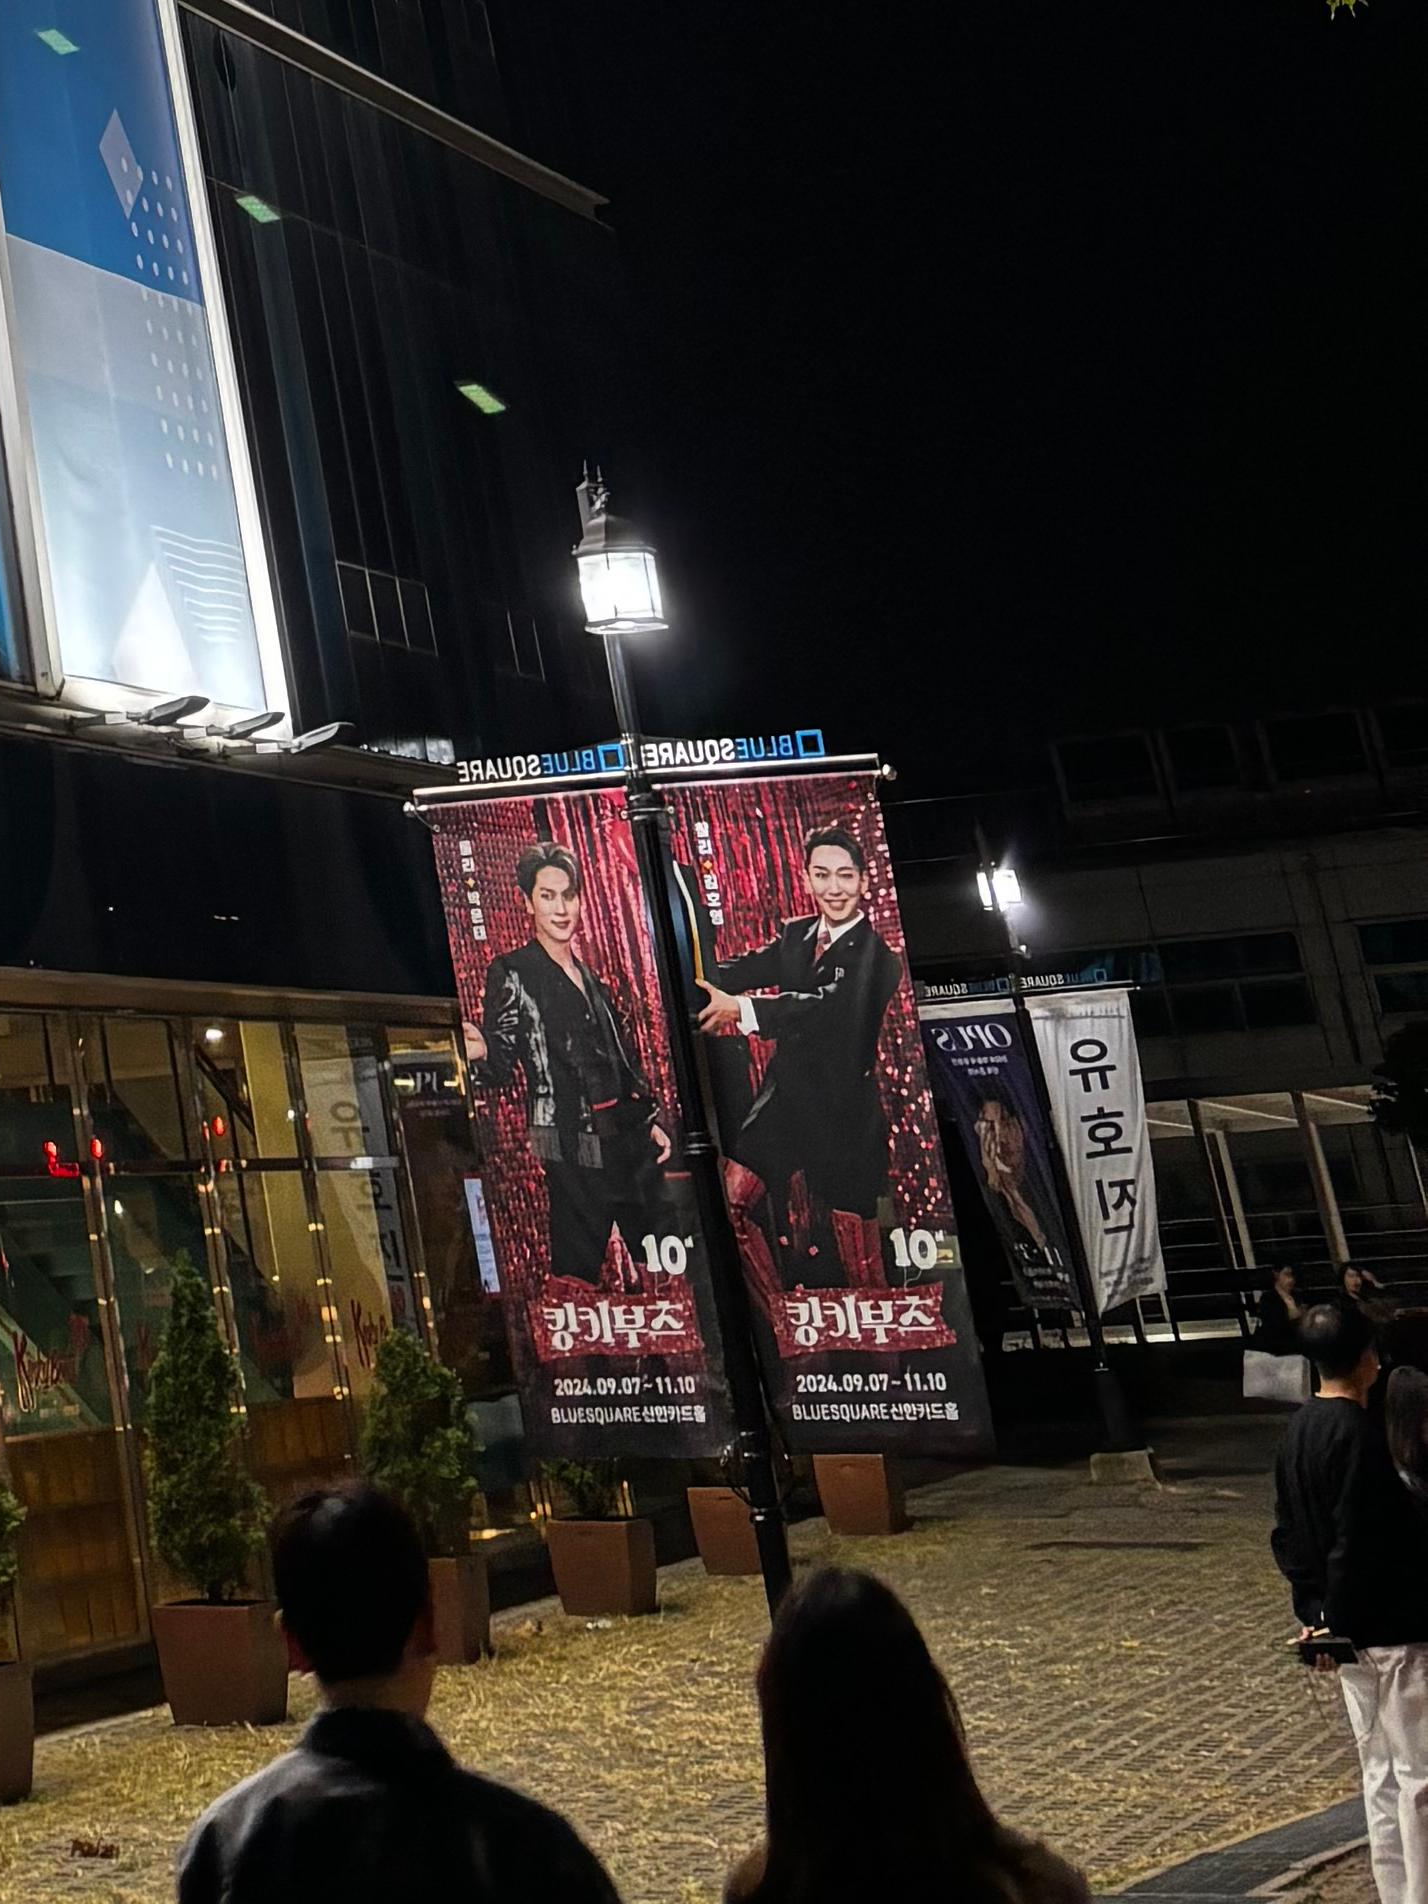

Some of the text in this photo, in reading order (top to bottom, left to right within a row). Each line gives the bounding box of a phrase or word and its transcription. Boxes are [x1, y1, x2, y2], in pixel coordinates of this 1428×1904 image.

[543, 1300, 686, 1351] 킹키부츠
[785, 1294, 937, 1346] 킹키부츠
[554, 1376, 641, 1397] 2024.09.07
[655, 1375, 695, 1395] 11.10
[796, 1373, 889, 1393] 2024.09.07
[904, 1372, 947, 1391] 11.10
